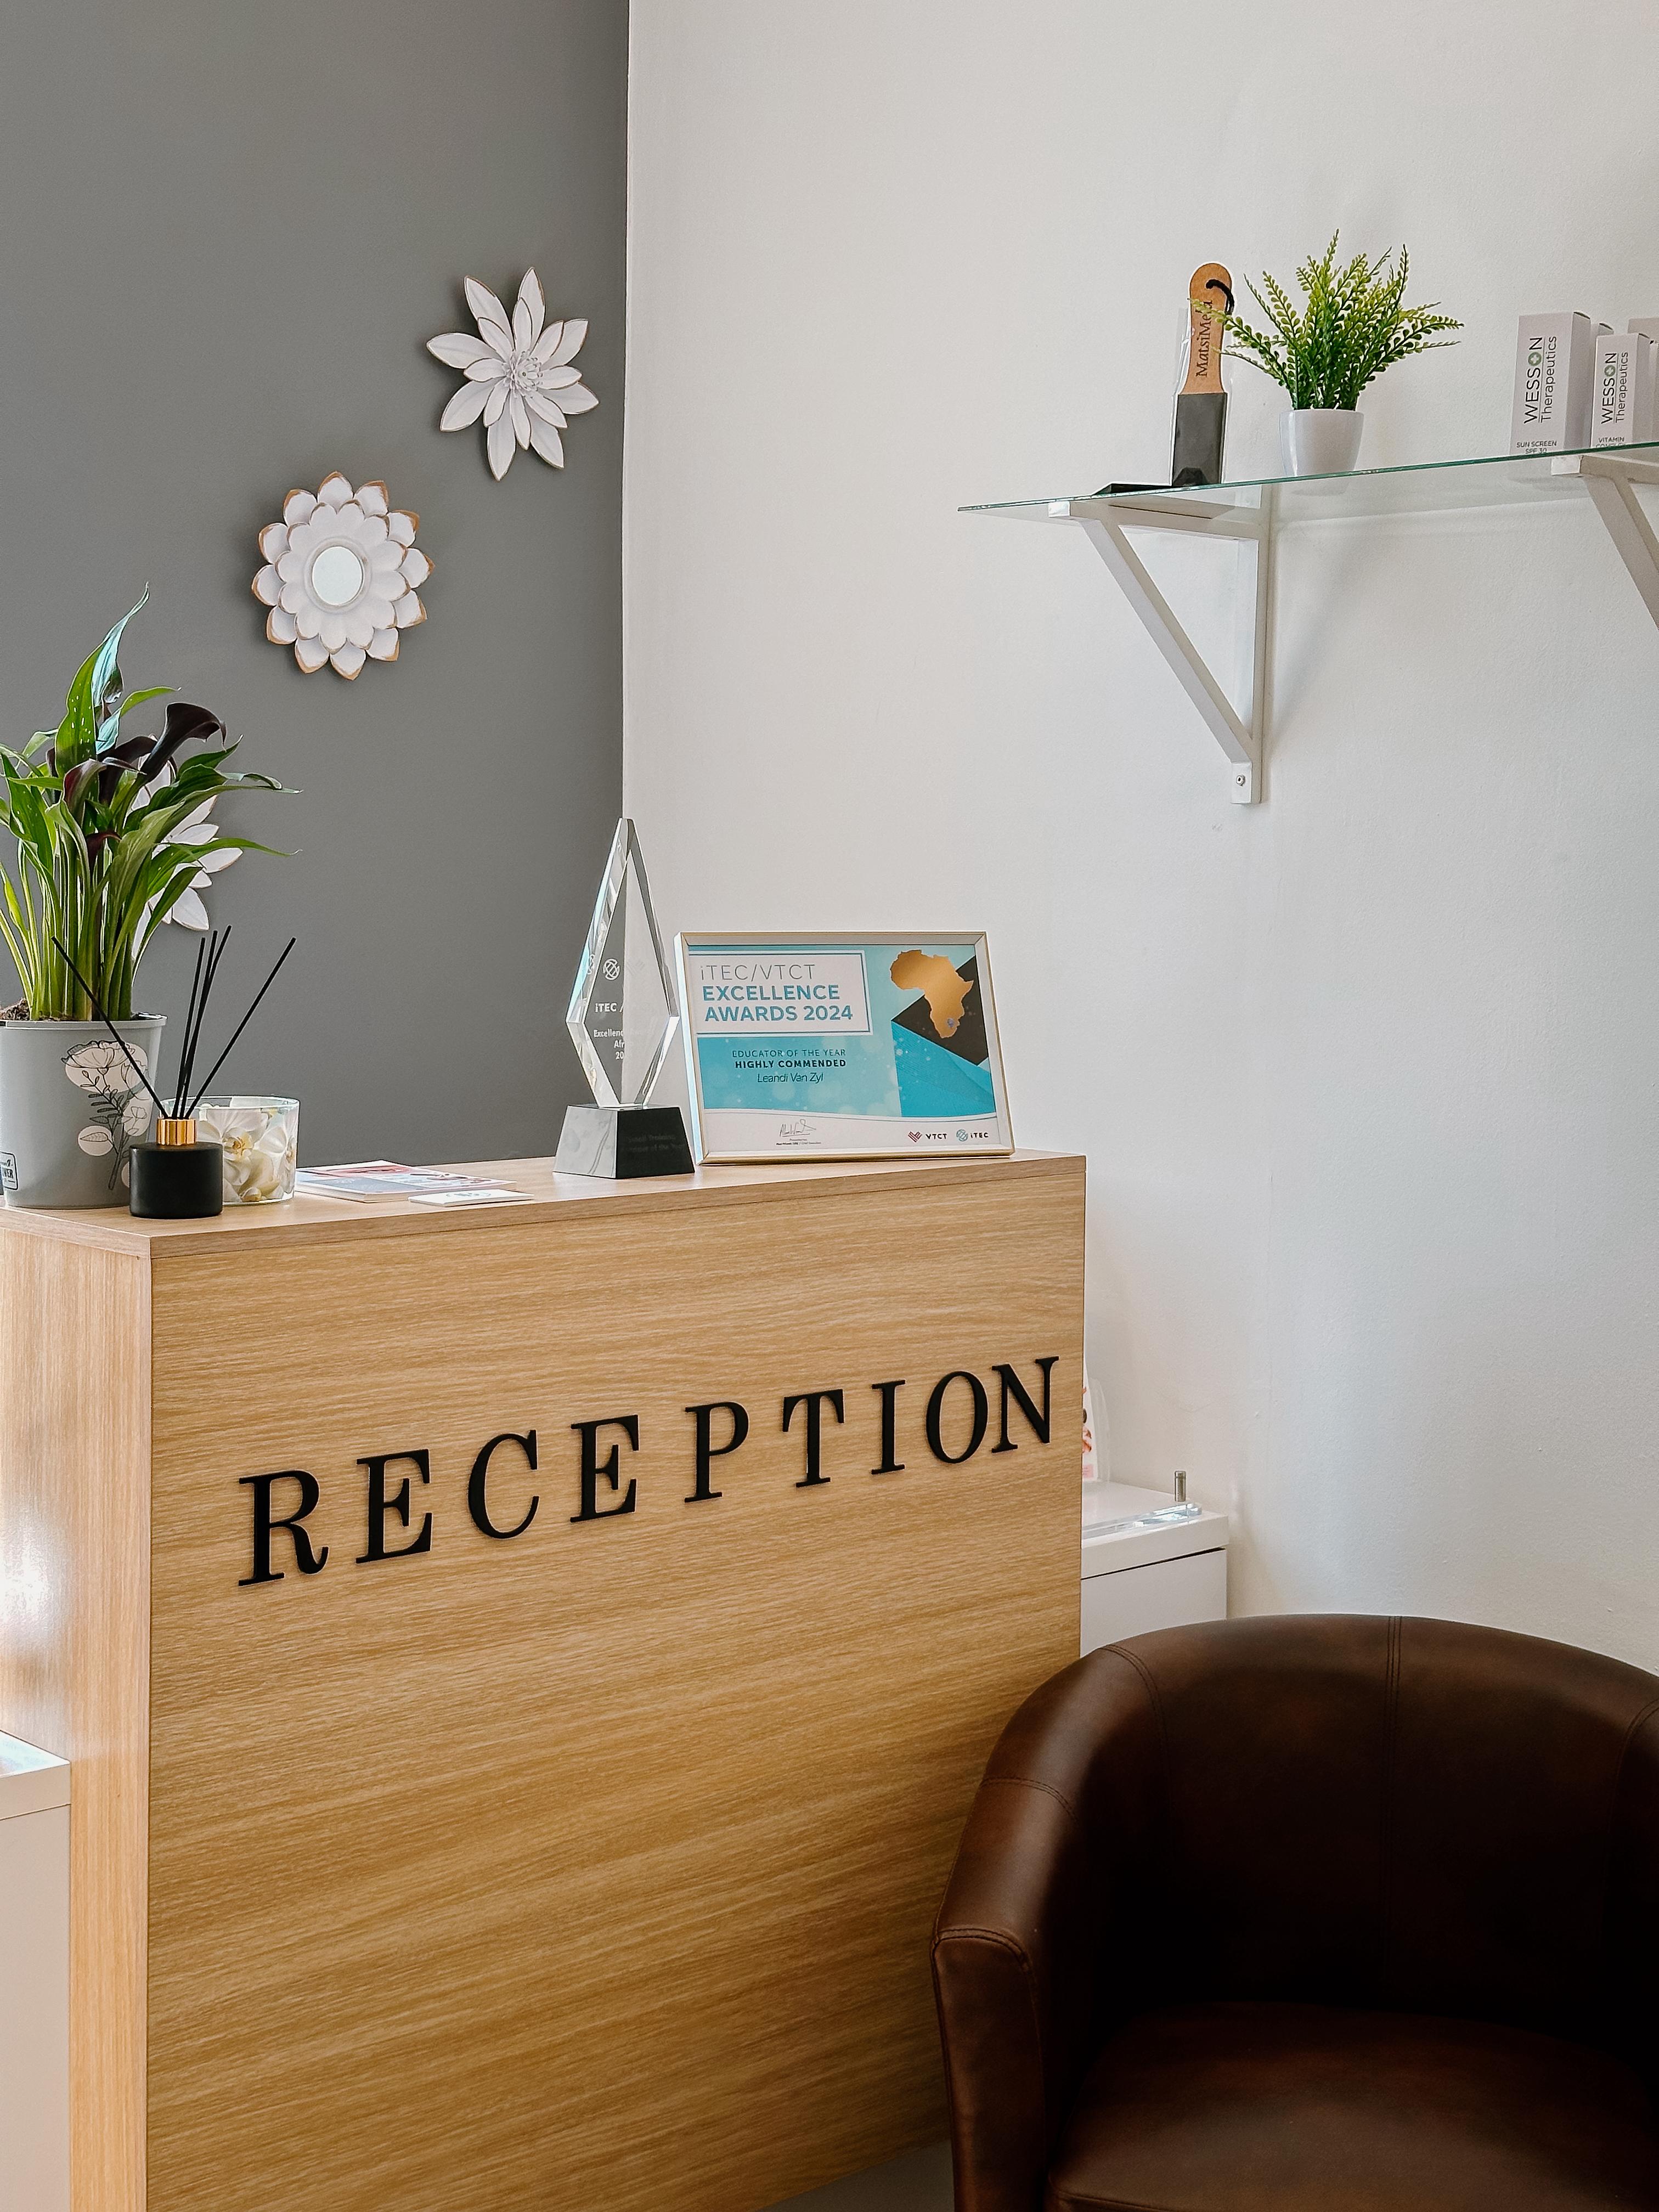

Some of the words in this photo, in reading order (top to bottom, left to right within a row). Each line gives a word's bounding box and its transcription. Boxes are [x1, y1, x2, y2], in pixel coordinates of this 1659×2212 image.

[1523, 337, 1543, 424] WESSON
[1541, 336, 1557, 423] Therapeutics
[1601, 352, 1617, 424] WESSON
[1616, 352, 1628, 423] Therapeutics
[699, 963, 816, 982] iTEC/VTCT
[702, 984, 840, 1001] EXCELLENCE
[595, 1002, 617, 1013] iTEC
[704, 1006, 798, 1022] AWARDS
[803, 1005, 853, 1021] 2024
[593, 1028, 624, 1038] Excellenc
[615, 1051, 624, 1060] 20
[732, 1049, 783, 1058] EDUCATOR
[786, 1049, 798, 1057] OF
[823, 1048, 846, 1057] YEAR
[735, 1059, 774, 1069] HIGHLY
[778, 1059, 847, 1068] COMMENDED
[757, 1073, 788, 1083] Leandi
[790, 1072, 808, 1082] Van
[809, 1071, 823, 1084] Zyl
[238, 1356, 1059, 1587] RECEPTION
